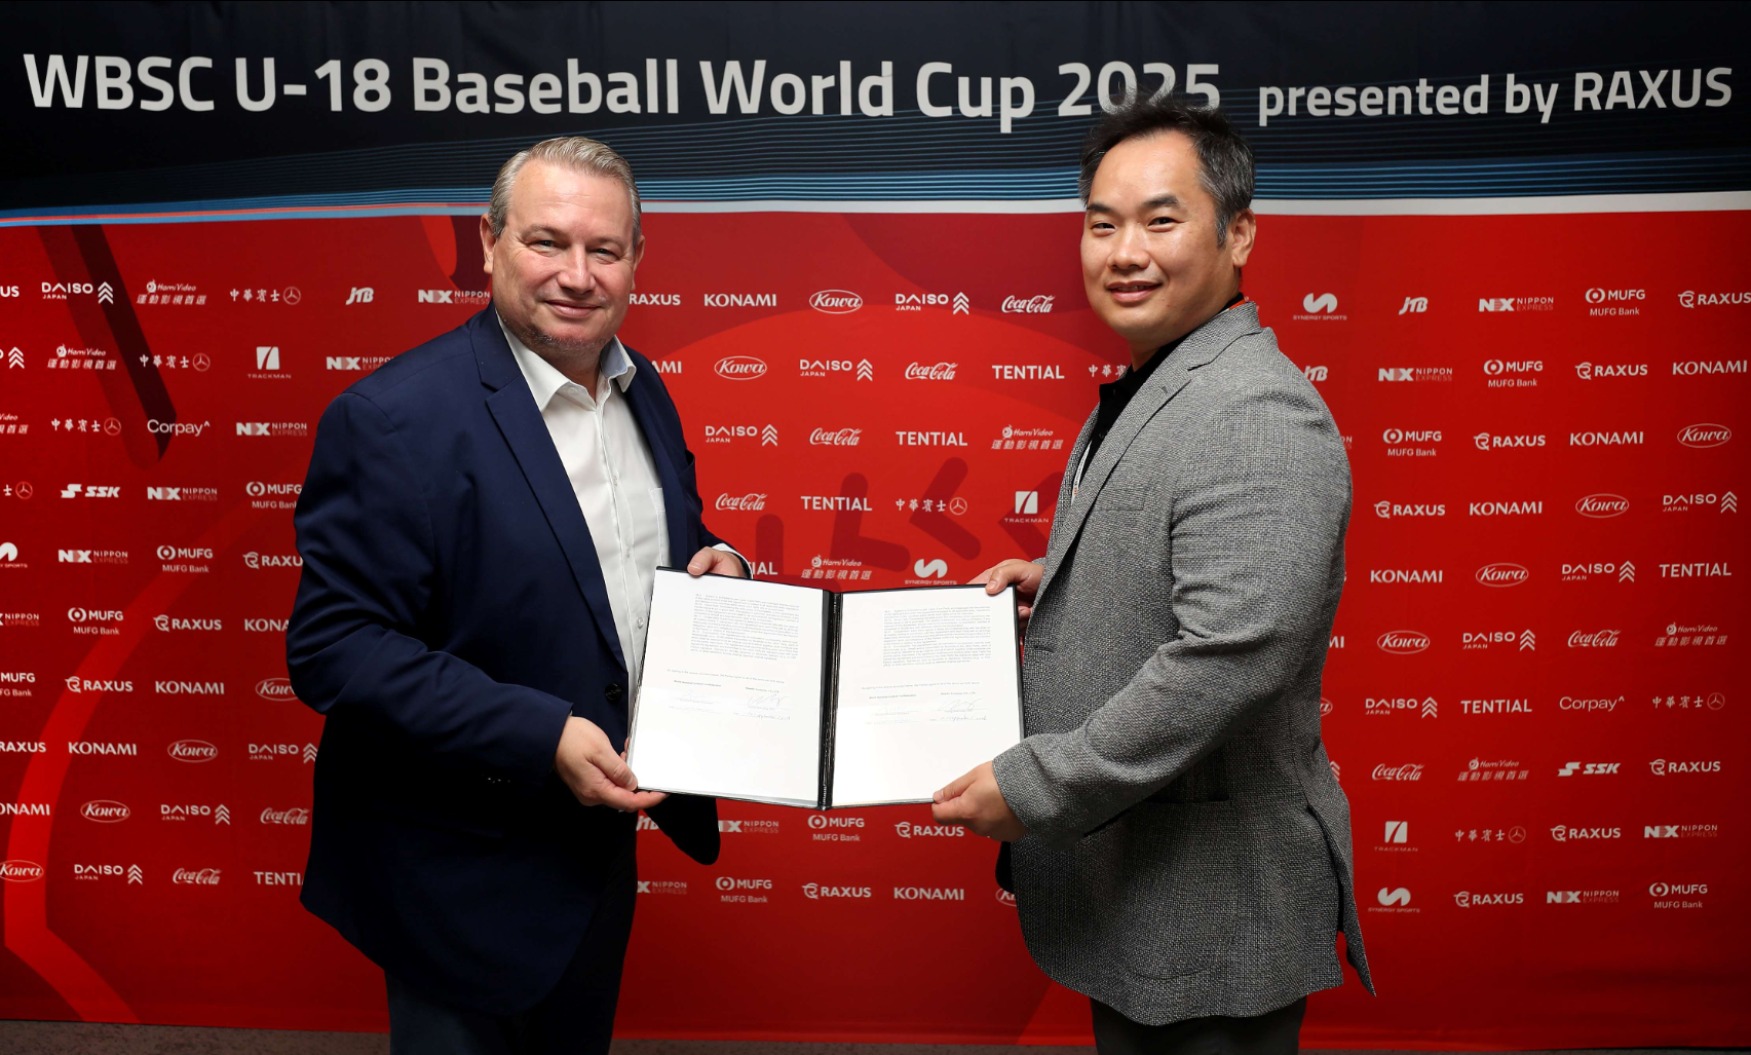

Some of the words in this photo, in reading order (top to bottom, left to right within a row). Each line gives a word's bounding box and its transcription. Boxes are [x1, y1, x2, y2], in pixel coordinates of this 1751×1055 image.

[23, 54, 214, 111] WBSC
[236, 57, 391, 112] U-18
[413, 58, 678, 114] Baseball
[700, 60, 893, 117] World
[917, 62, 1034, 133] Cup
[1058, 61, 1220, 116] 2025
[1259, 74, 1489, 126] presented
[1506, 74, 1558, 123] by
[1574, 67, 1732, 111] RAXUS
[42, 282, 93, 294] DAISO
[454, 291, 490, 299] NIPPON
[629, 294, 680, 305] RAXUS
[896, 294, 949, 304] DAISO
[1608, 289, 1645, 300] MUFG
[1698, 292, 1751, 305] RAXUS
[704, 294, 776, 307] KONAMI
[813, 293, 860, 308] Kowa
[1590, 308, 1616, 316] MUFG
[1618, 307, 1639, 315] Bank
[719, 360, 765, 376] Kowa
[800, 359, 852, 371] DAISO
[1506, 361, 1543, 372] MUFG
[1595, 364, 1647, 376] RAXUS
[1673, 360, 1747, 375] KONAMI
[992, 365, 1064, 379] TENTIAL
[1488, 379, 1514, 387] MUFG
[705, 426, 757, 436] DAISO
[1406, 431, 1442, 441] MUFG
[1682, 426, 1730, 441] Kowa
[896, 432, 967, 446] TENTIAL
[1493, 435, 1545, 447] RAXUS
[1570, 432, 1643, 445] KONAMI
[1388, 448, 1414, 456] MUFG
[1416, 448, 1436, 456] Bank
[85, 486, 120, 497] SSK
[267, 484, 302, 494] MUFG
[801, 496, 872, 511] TENTIAL
[1580, 498, 1627, 512] Kowa
[1663, 494, 1716, 505] DAISO
[1393, 505, 1445, 516] RAXUS
[1470, 501, 1542, 515] KONAMI
[93, 550, 128, 558] NIPPON
[178, 548, 213, 558] MUFG
[1562, 563, 1615, 574] DAISO
[1659, 563, 1731, 577] TENTIAL
[1371, 570, 1442, 583] KONAMI
[1480, 567, 1527, 582] Kowa
[89, 610, 123, 621] MUFG
[74, 626, 98, 634] MUFG
[172, 619, 222, 630] RAXUS
[1381, 634, 1428, 649] Kowa
[1463, 632, 1515, 643] DAISO
[1, 673, 35, 682] MUFG
[84, 680, 133, 692] RAXUS
[155, 681, 224, 694] KONAMI
[1366, 698, 1417, 709] DAISO
[1461, 699, 1532, 713] TENTIAL
[69, 742, 136, 755] KONAMI
[172, 743, 215, 758] Kowa
[249, 744, 299, 754] DAISO
[1583, 763, 1620, 774] SSK
[1669, 761, 1720, 772] RAXUS
[0, 803, 50, 815] ONAMI
[84, 803, 128, 817] Kowa
[161, 804, 211, 815] DAISO
[744, 820, 779, 828] NIPPON
[829, 818, 864, 827] MUFG
[914, 825, 964, 836] RAXUS
[1569, 828, 1621, 838] RAXUS
[0, 863, 41, 876] Kowa
[74, 864, 123, 875] DAISO
[254, 872, 301, 885] TENTI
[737, 879, 772, 889] MUFG
[821, 887, 871, 897] RAXUS
[894, 887, 964, 900] KONAMI
[1672, 884, 1707, 894] MUFG
[1473, 893, 1523, 904] RAXUS
